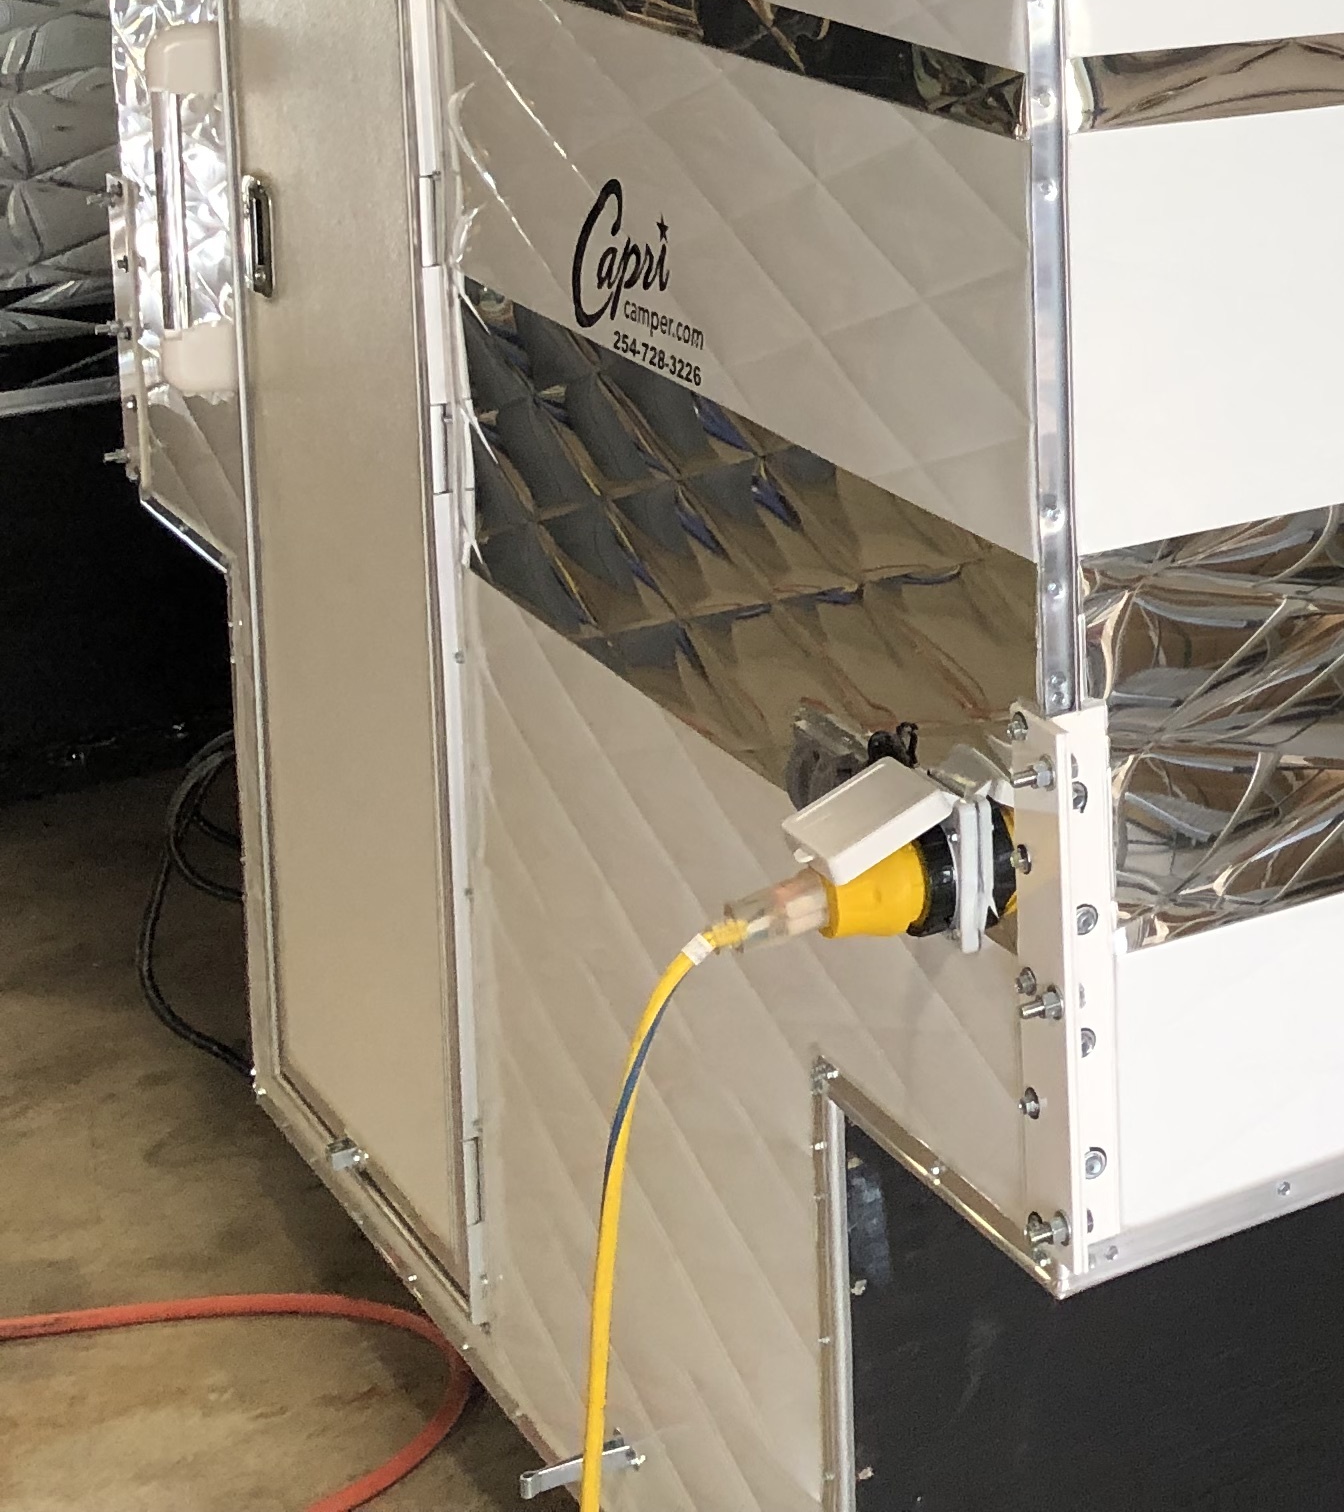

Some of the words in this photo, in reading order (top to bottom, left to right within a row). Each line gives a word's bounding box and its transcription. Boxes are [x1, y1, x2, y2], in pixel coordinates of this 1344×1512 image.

[571, 178, 669, 328] Capri
[623, 298, 704, 351] camper.com
[613, 330, 702, 387] 254-728-3226
